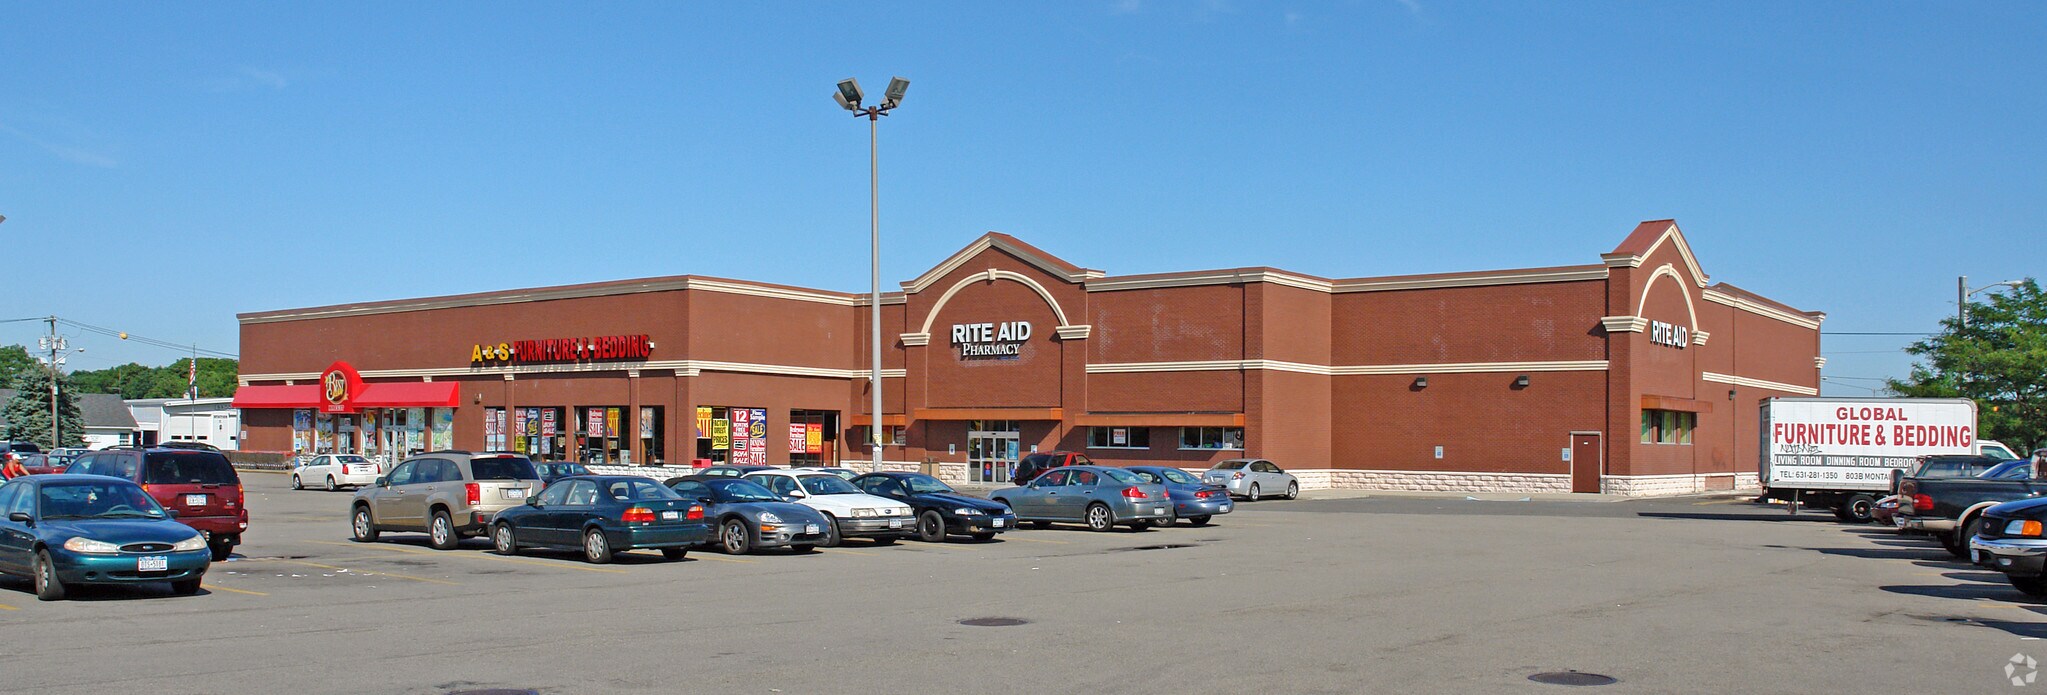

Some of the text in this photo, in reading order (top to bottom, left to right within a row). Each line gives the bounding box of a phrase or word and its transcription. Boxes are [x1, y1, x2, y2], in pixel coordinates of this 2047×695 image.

[953, 321, 1031, 343] RITE AID
[1652, 320, 1687, 347] RITE AID
[471, 335, 649, 362] A & S FURNITURE & BEDDING
[734, 410, 748, 422] 12
[1836, 407, 1908, 421] GLOBAL
[1774, 423, 1971, 447] FURNITURE & BEDDING
[789, 440, 805, 451] SALE
[750, 453, 765, 466] SALE
[1775, 455, 1917, 468] LIVING ROOM DINNING ROOM BEDROO
[1796, 471, 1839, 479] 631-281-1350
